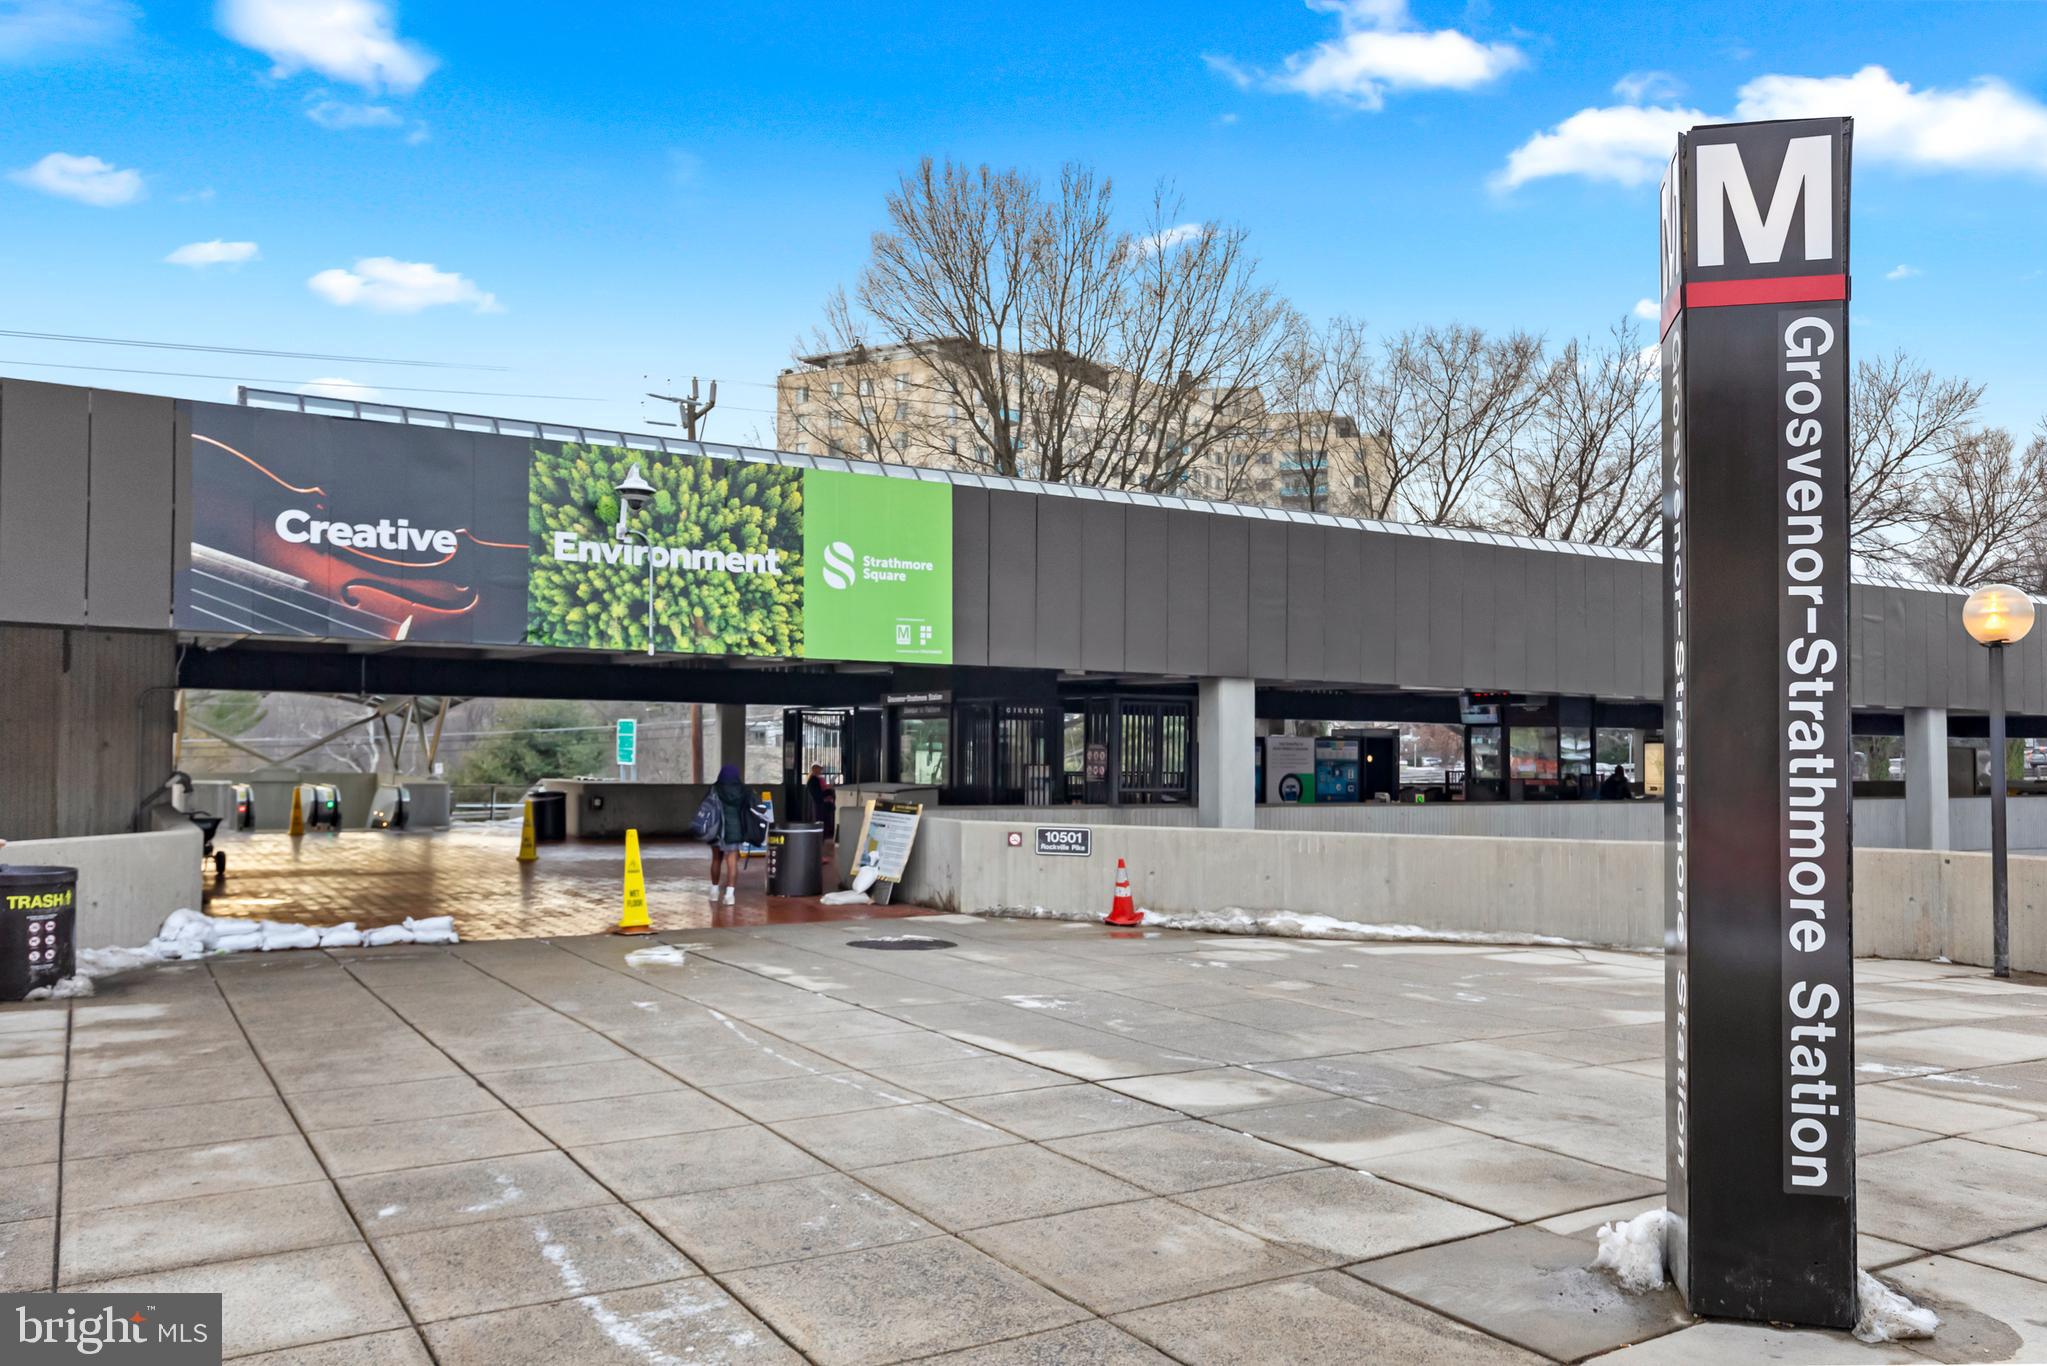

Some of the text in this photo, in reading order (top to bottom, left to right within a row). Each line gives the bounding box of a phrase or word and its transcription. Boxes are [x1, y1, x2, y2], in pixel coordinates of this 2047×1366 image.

[1697, 134, 1832, 267] M
[275, 509, 457, 554] Creative
[554, 531, 782, 575] Environment
[863, 555, 933, 571] Strathmore
[863, 568, 907, 583] Square
[1672, 330, 1687, 1169] Grosvenor-Strathmore Station
[1784, 316, 1840, 1187] Grosvenor-Strathmore Station
[1040, 843, 1070, 851] Rockville
[1045, 831, 1082, 843] 10501
[6, 893, 63, 909] TRASH
